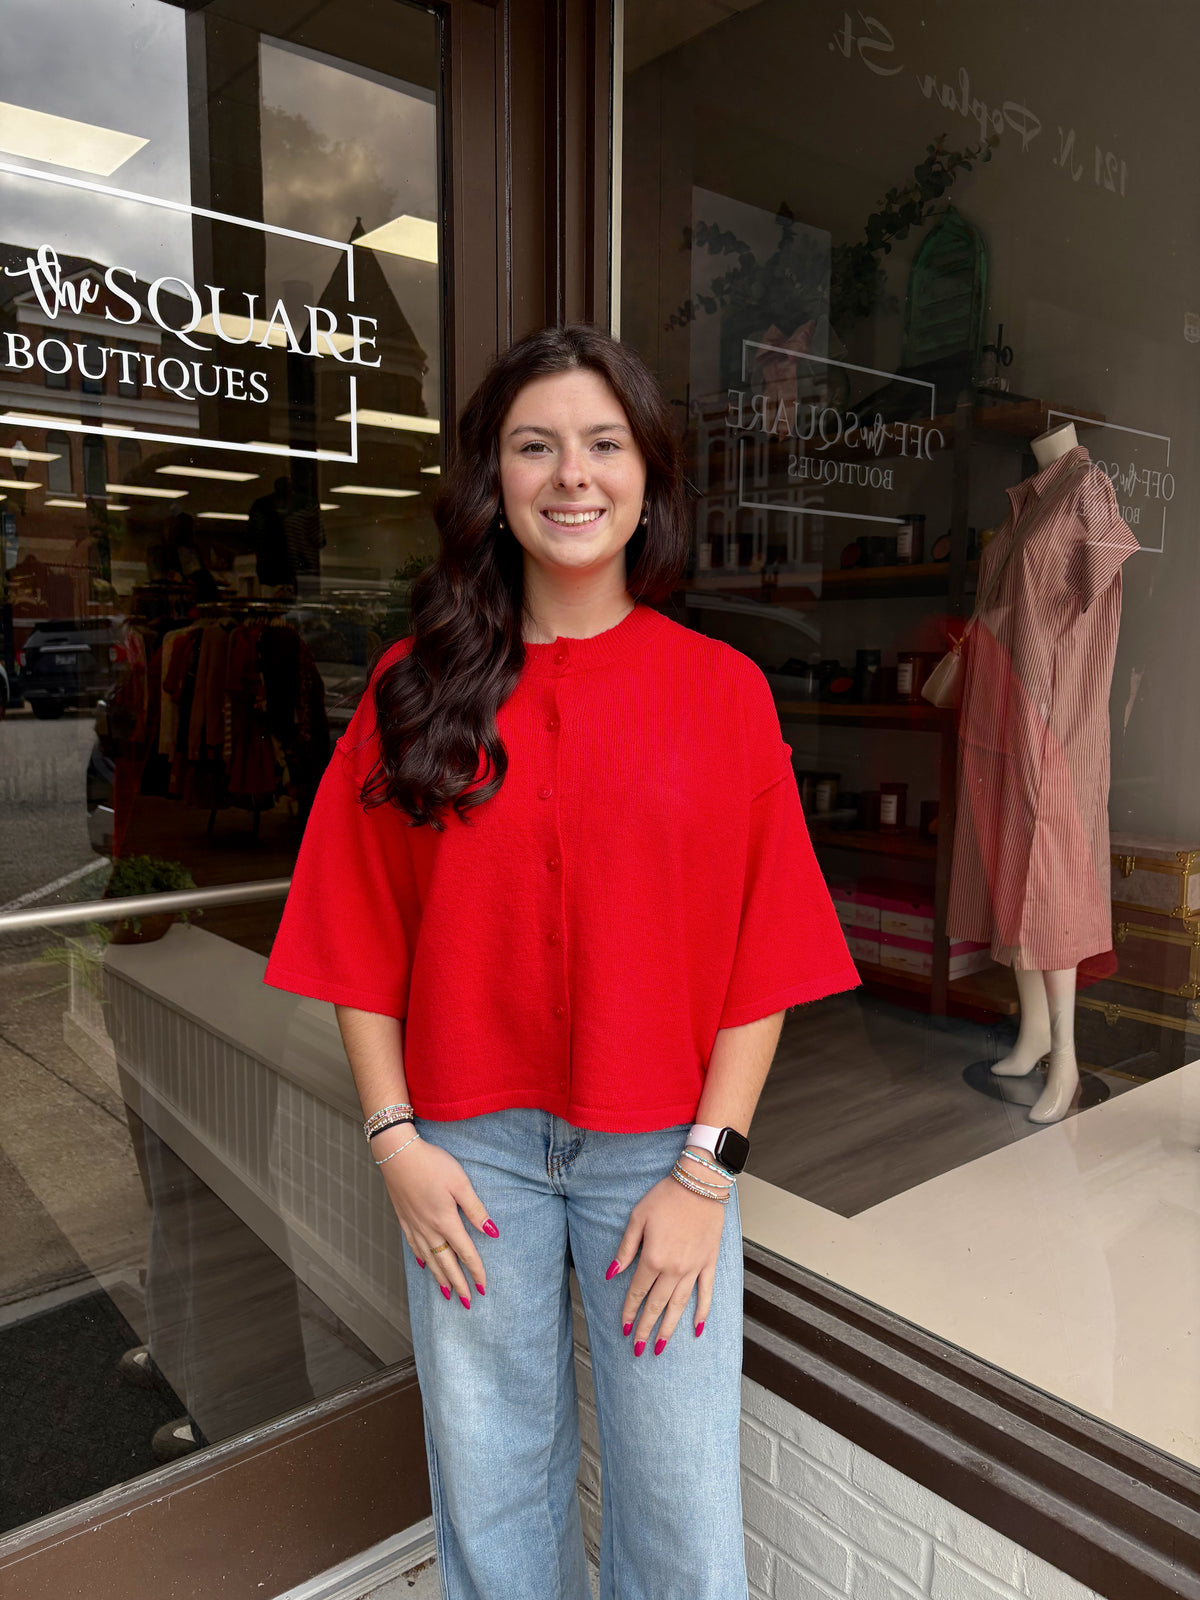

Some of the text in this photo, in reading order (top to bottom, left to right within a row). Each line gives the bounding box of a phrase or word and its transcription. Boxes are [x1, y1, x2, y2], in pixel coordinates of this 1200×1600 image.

[4, 243, 382, 368] the SQUARE
[3, 331, 270, 403] BOUTIQUES
